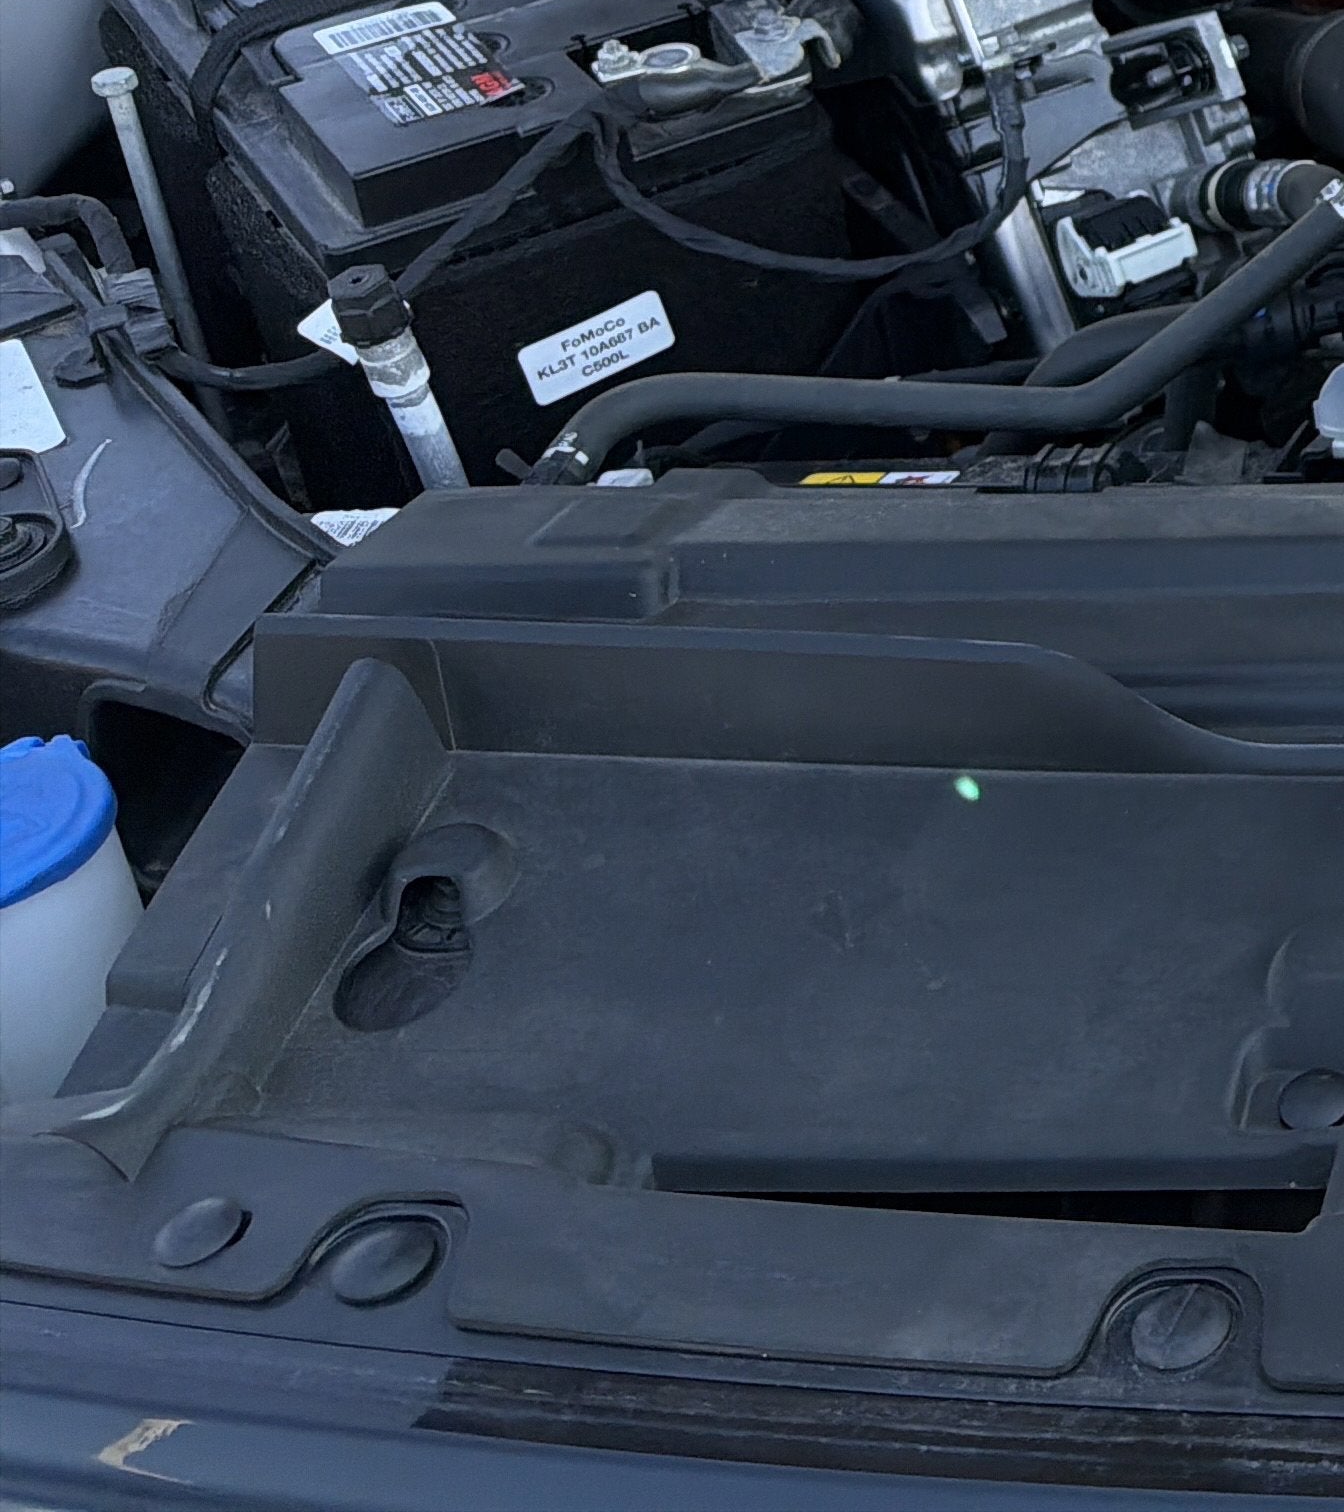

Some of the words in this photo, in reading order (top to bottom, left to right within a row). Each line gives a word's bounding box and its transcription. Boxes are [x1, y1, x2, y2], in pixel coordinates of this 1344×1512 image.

[536, 353, 577, 381] KL3T
[637, 316, 661, 335] BA
[560, 317, 626, 353] FoMoCo
[581, 349, 631, 377] C500L
